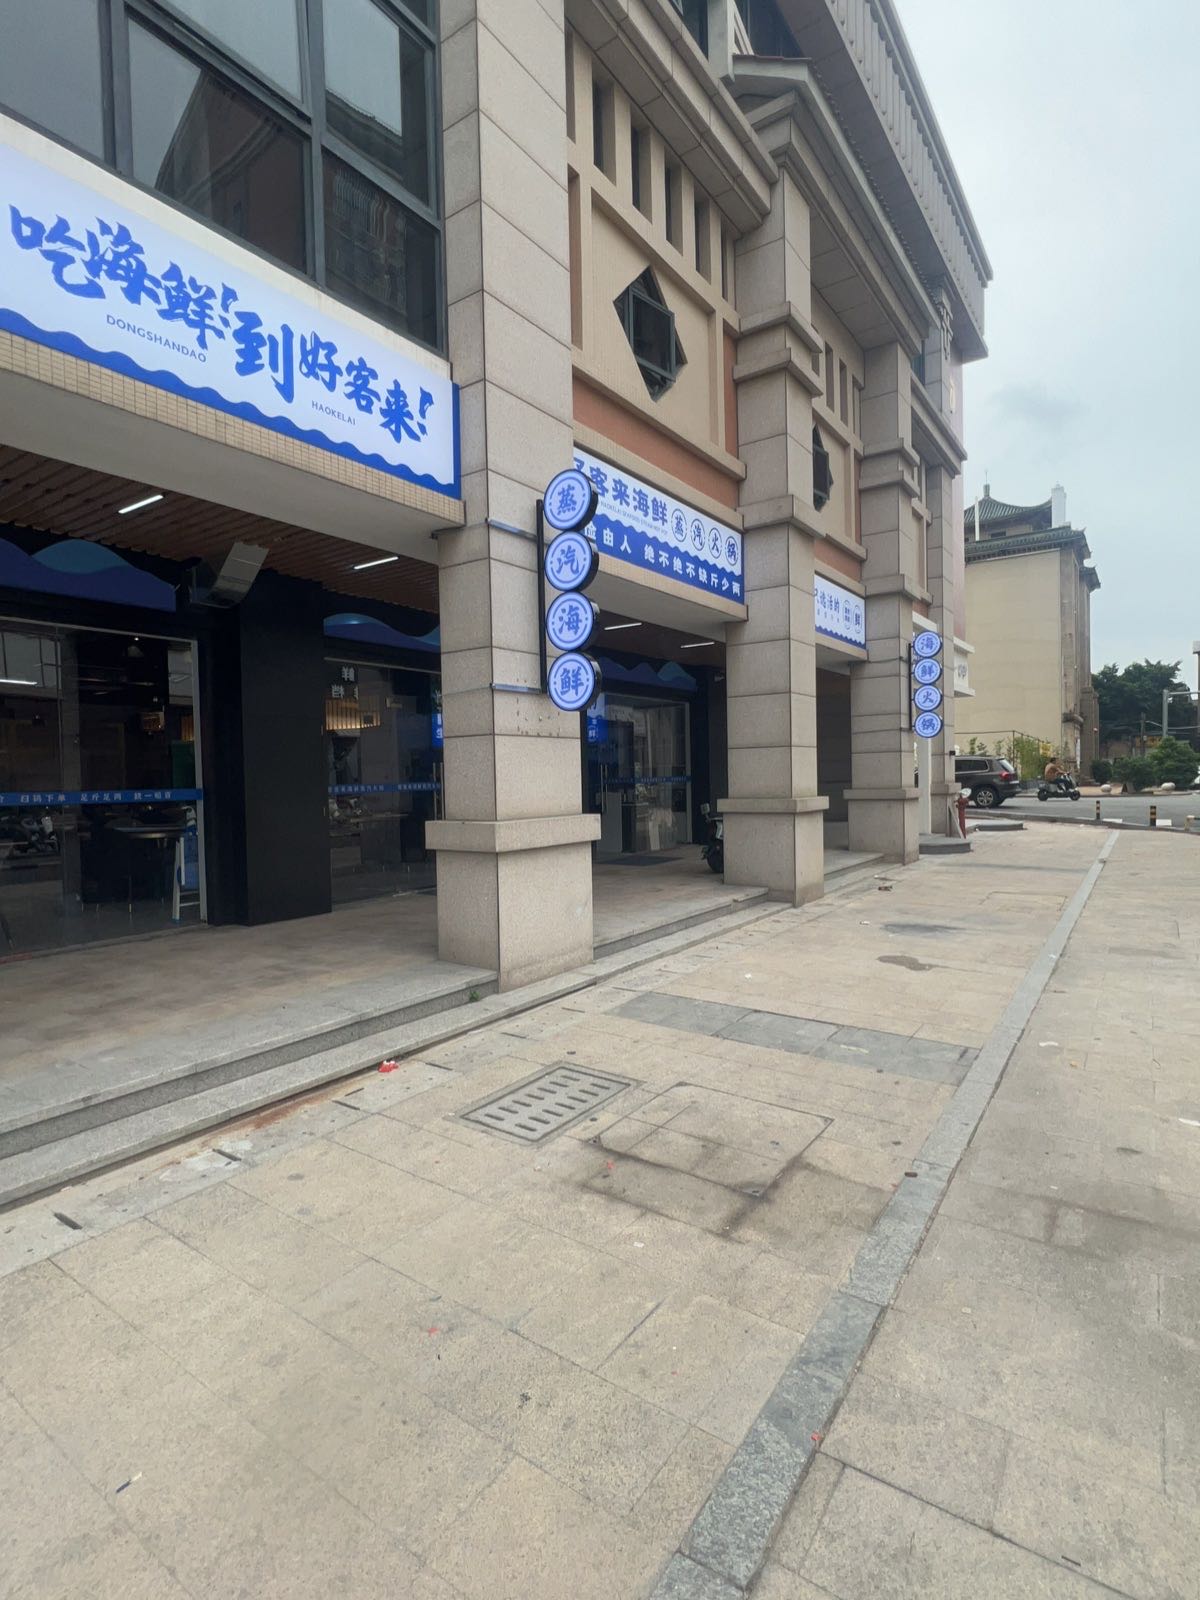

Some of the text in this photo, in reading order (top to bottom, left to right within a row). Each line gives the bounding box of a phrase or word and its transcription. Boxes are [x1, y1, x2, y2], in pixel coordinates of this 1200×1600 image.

[106, 313, 207, 363] DONGSHANDAO
[311, 400, 357, 426] HAOKELAI
[553, 482, 587, 699] 蒸汽海鲜
[918, 635, 937, 732] 海鲜火锅
